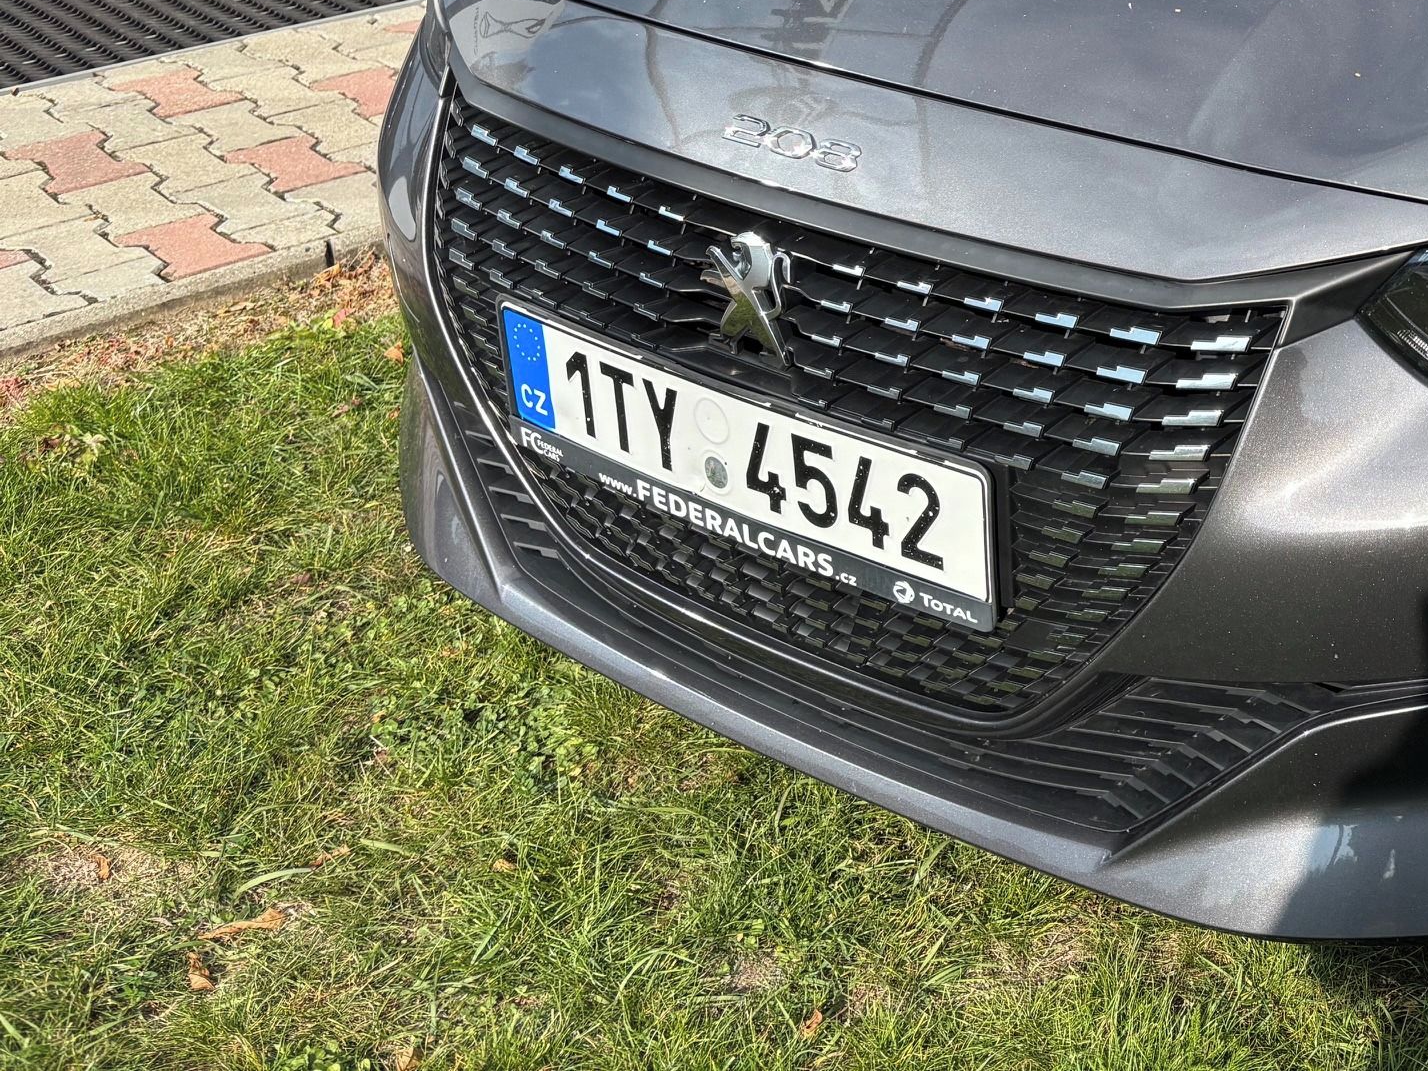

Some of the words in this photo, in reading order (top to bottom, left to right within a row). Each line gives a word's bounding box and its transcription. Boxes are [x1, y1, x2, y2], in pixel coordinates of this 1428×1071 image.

[721, 114, 862, 173] 208
[520, 382, 549, 417] CZ
[565, 351, 678, 472] 1TY
[746, 423, 944, 571] 4542
[598, 472, 858, 587] www.FEDERALCARS.cz
[918, 592, 979, 624] TOTAL
